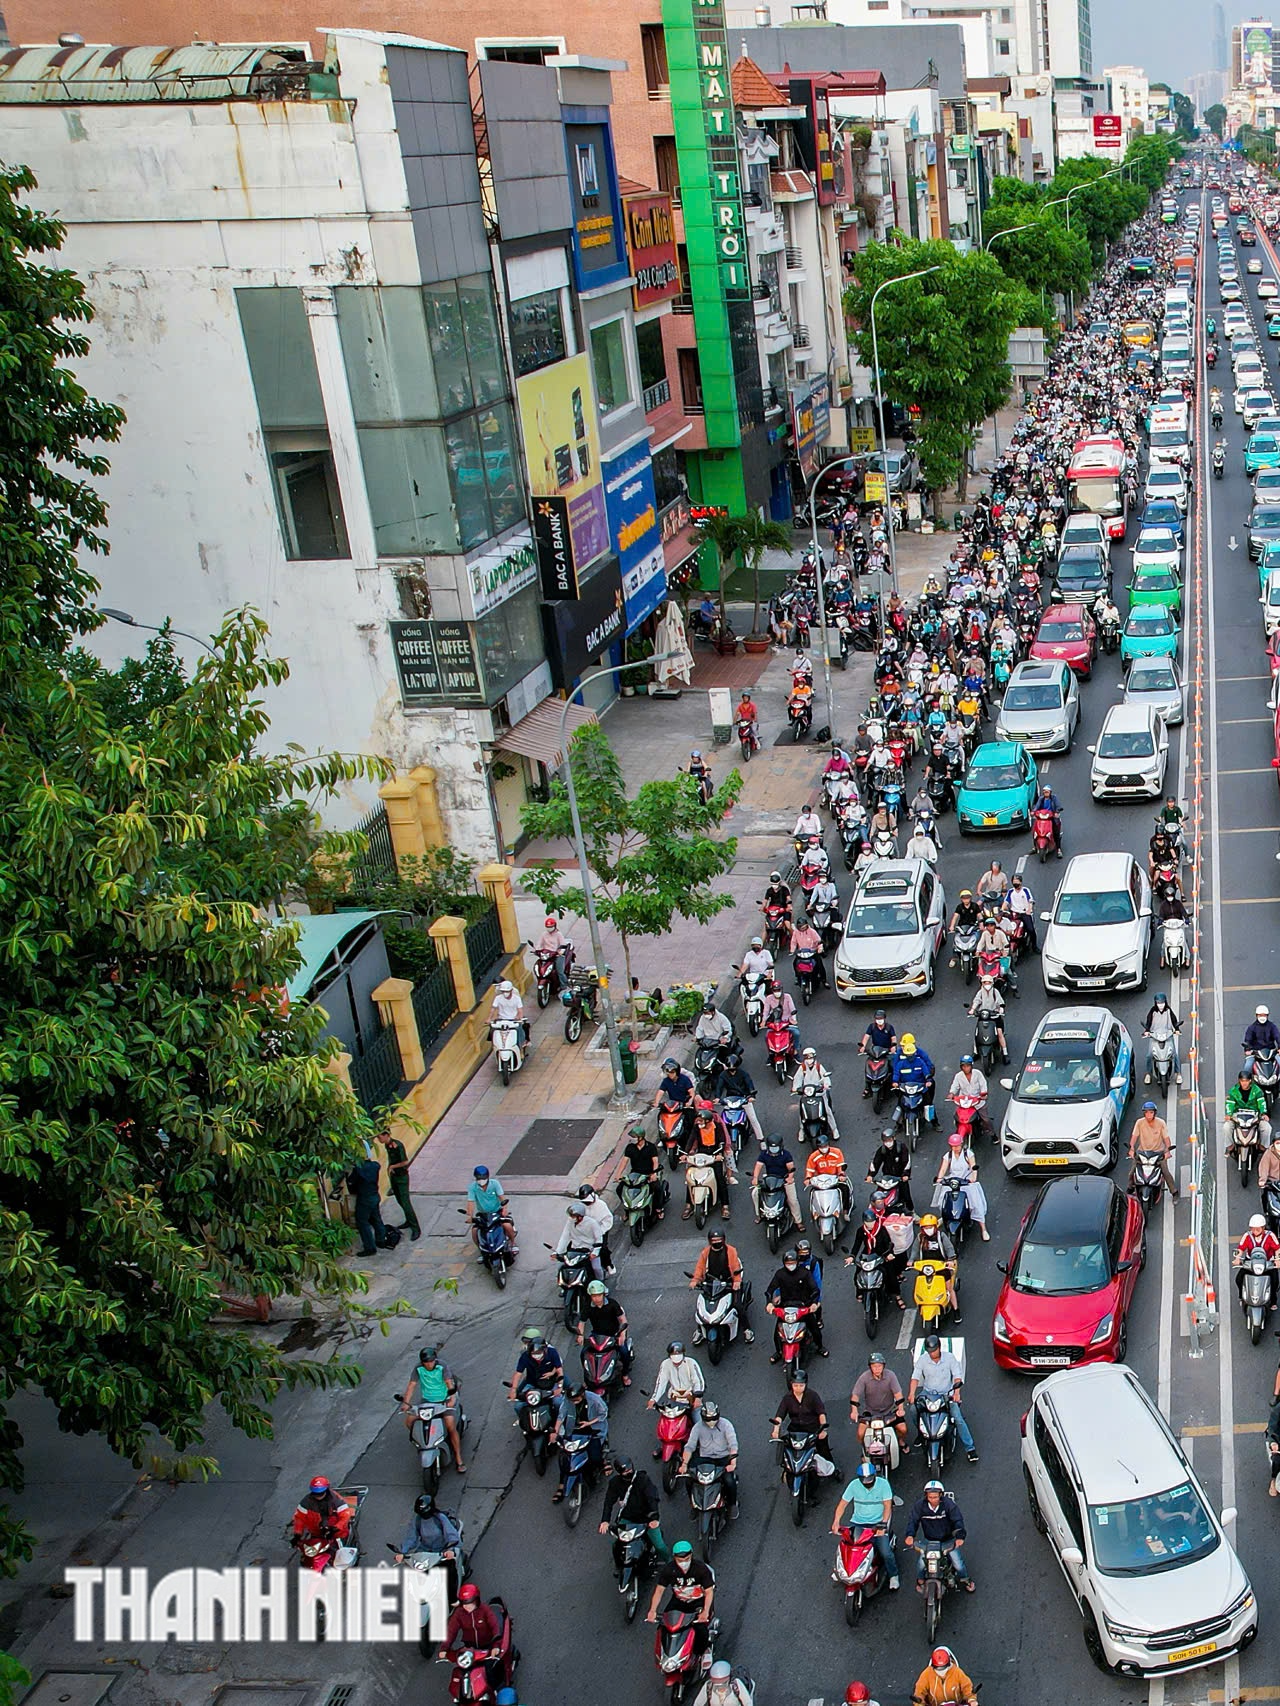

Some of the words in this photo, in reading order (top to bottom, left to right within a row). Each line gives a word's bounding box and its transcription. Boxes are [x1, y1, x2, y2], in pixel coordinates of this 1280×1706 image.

[702, 44, 725, 132] MẶT
[717, 173, 740, 285] TRỜI
[549, 512, 566, 549] BANK
[555, 552, 567, 562] A
[556, 564, 569, 590] BAC
[401, 626, 422, 637] UỐNG
[440, 626, 461, 636] UỐNG
[586, 625, 600, 652] BAC
[599, 623, 605, 637] A
[604, 610, 622, 635] BANK
[397, 640, 432, 656] COFFEE
[436, 639, 471, 656] COFFEE
